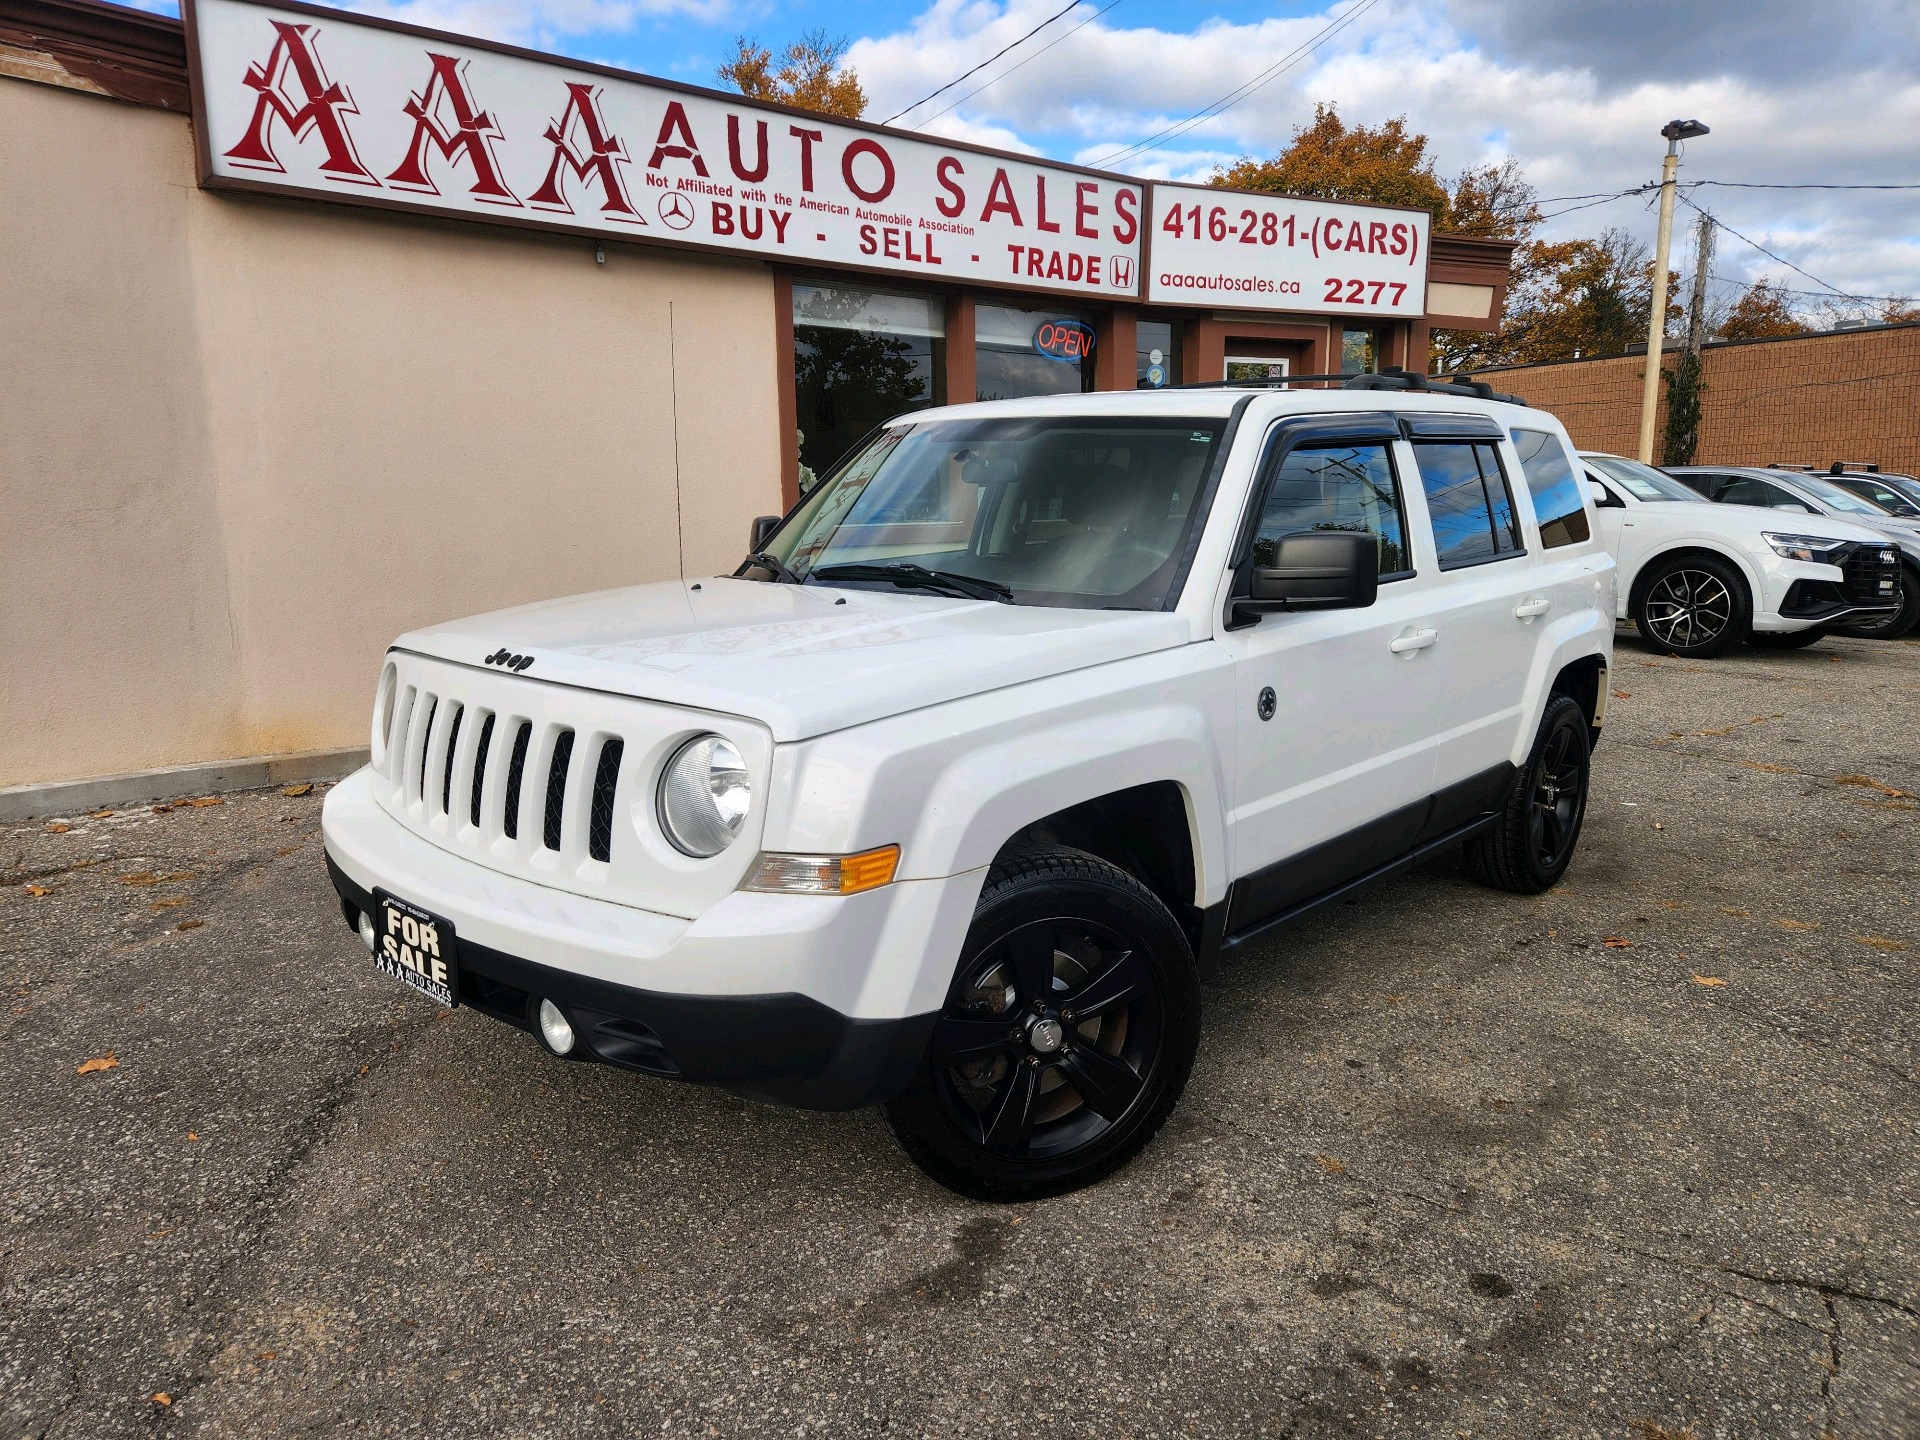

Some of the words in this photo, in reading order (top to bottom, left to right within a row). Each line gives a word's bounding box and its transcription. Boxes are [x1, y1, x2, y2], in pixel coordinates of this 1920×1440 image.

[647, 101, 896, 204] AUTO
[936, 157, 1138, 245] SALES
[645, 173, 669, 189] Not
[676, 177, 734, 198] Affiliated
[740, 190, 767, 203] with
[773, 193, 793, 206] the
[799, 196, 850, 216] American
[855, 207, 913, 227] Automobile
[918, 217, 975, 236] Association
[711, 201, 792, 245] BUY
[859, 224, 942, 265] SELL
[1007, 244, 1101, 285] TRADE
[1163, 202, 1419, 266] 416-281-(CARS)
[1159, 272, 1301, 295] aaaautosales.ca
[1323, 277, 1408, 307] 2277
[1038, 323, 1093, 358] OPEN
[484, 647, 536, 674] Jeep
[387, 907, 441, 957] FOR
[382, 935, 449, 988] SALE
[405, 968, 425, 987] AUTO
[426, 980, 452, 1002] SALES
